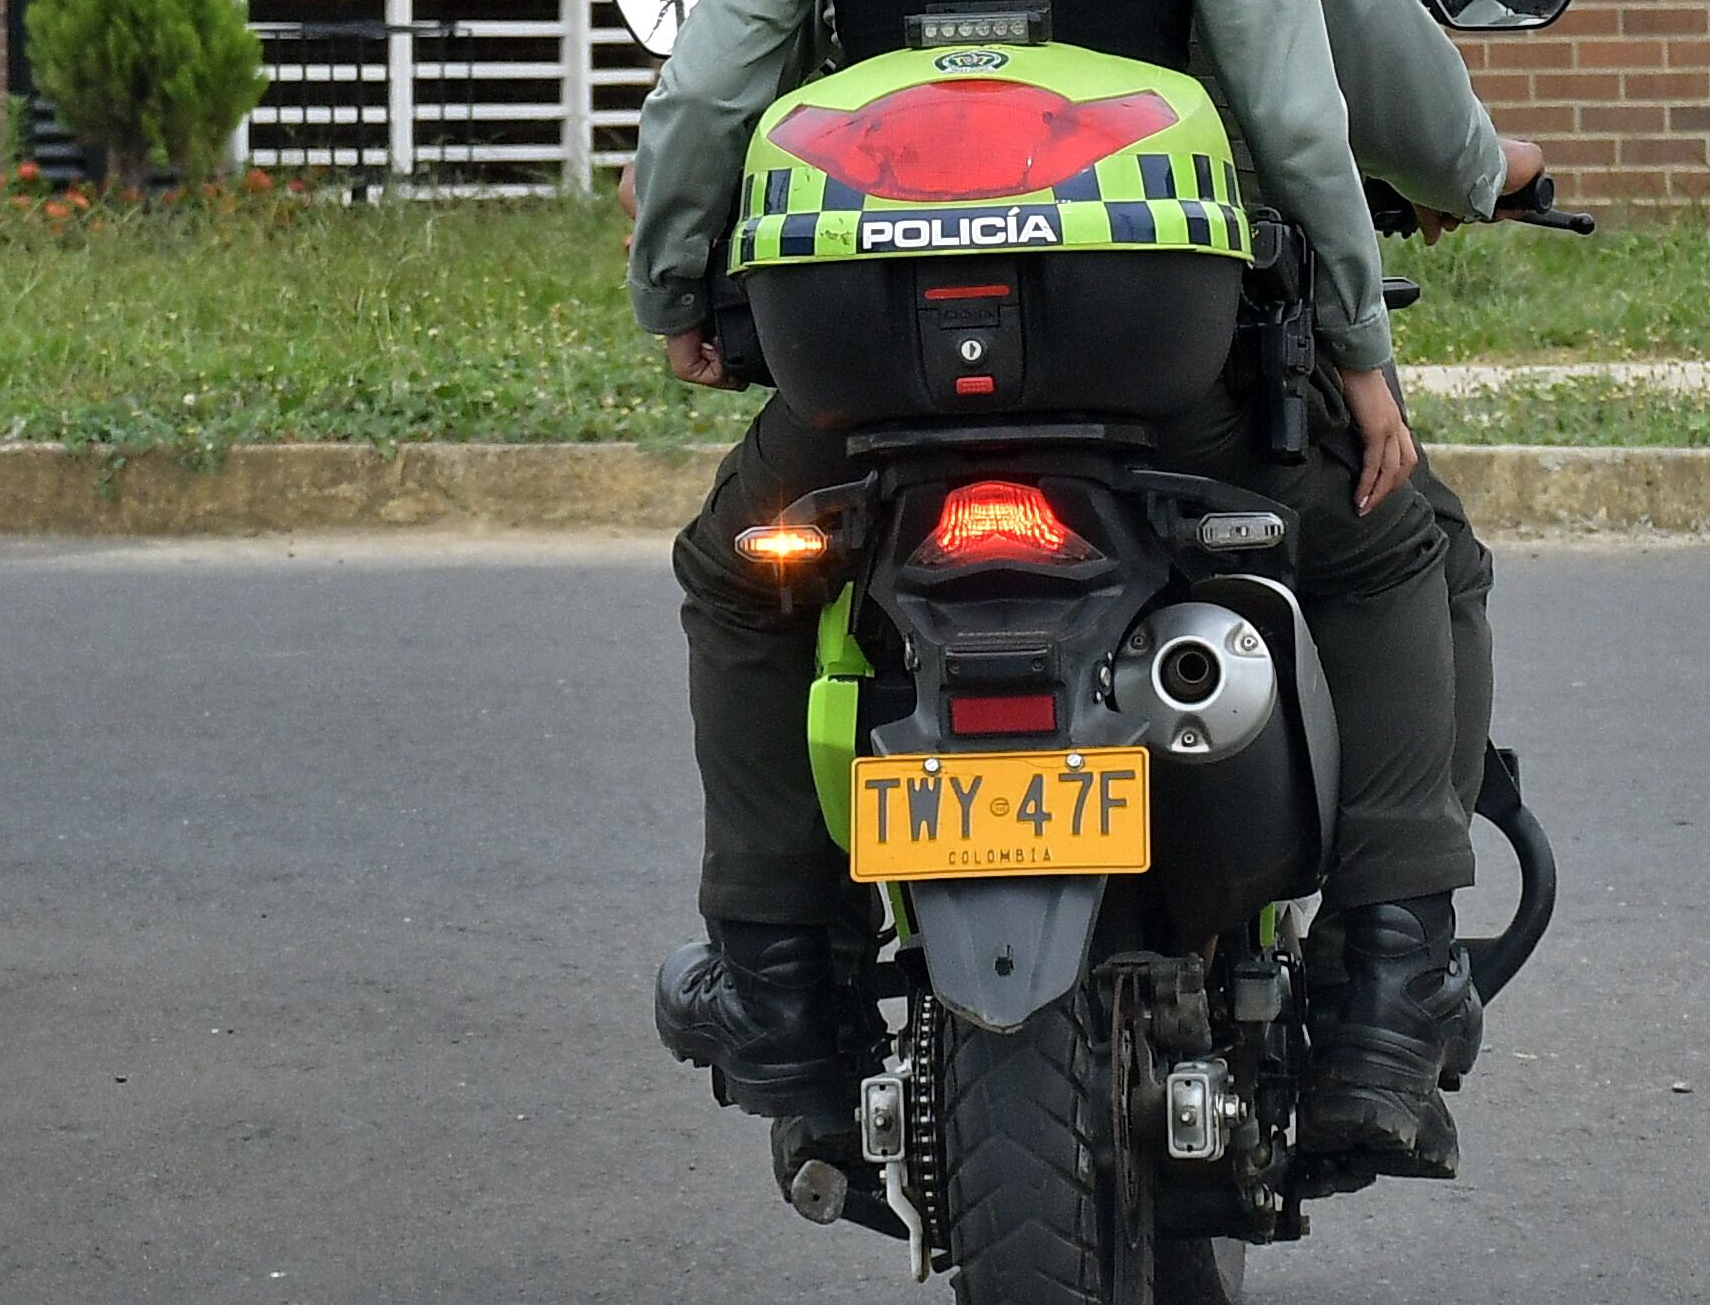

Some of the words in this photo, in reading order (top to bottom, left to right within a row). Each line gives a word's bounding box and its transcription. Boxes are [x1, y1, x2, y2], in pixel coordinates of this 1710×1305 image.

[861, 205, 1059, 250] POLICÍA
[864, 773, 984, 845] TWY
[1015, 769, 1136, 838] 47F
[947, 847, 1053, 866] COLOMBIA
